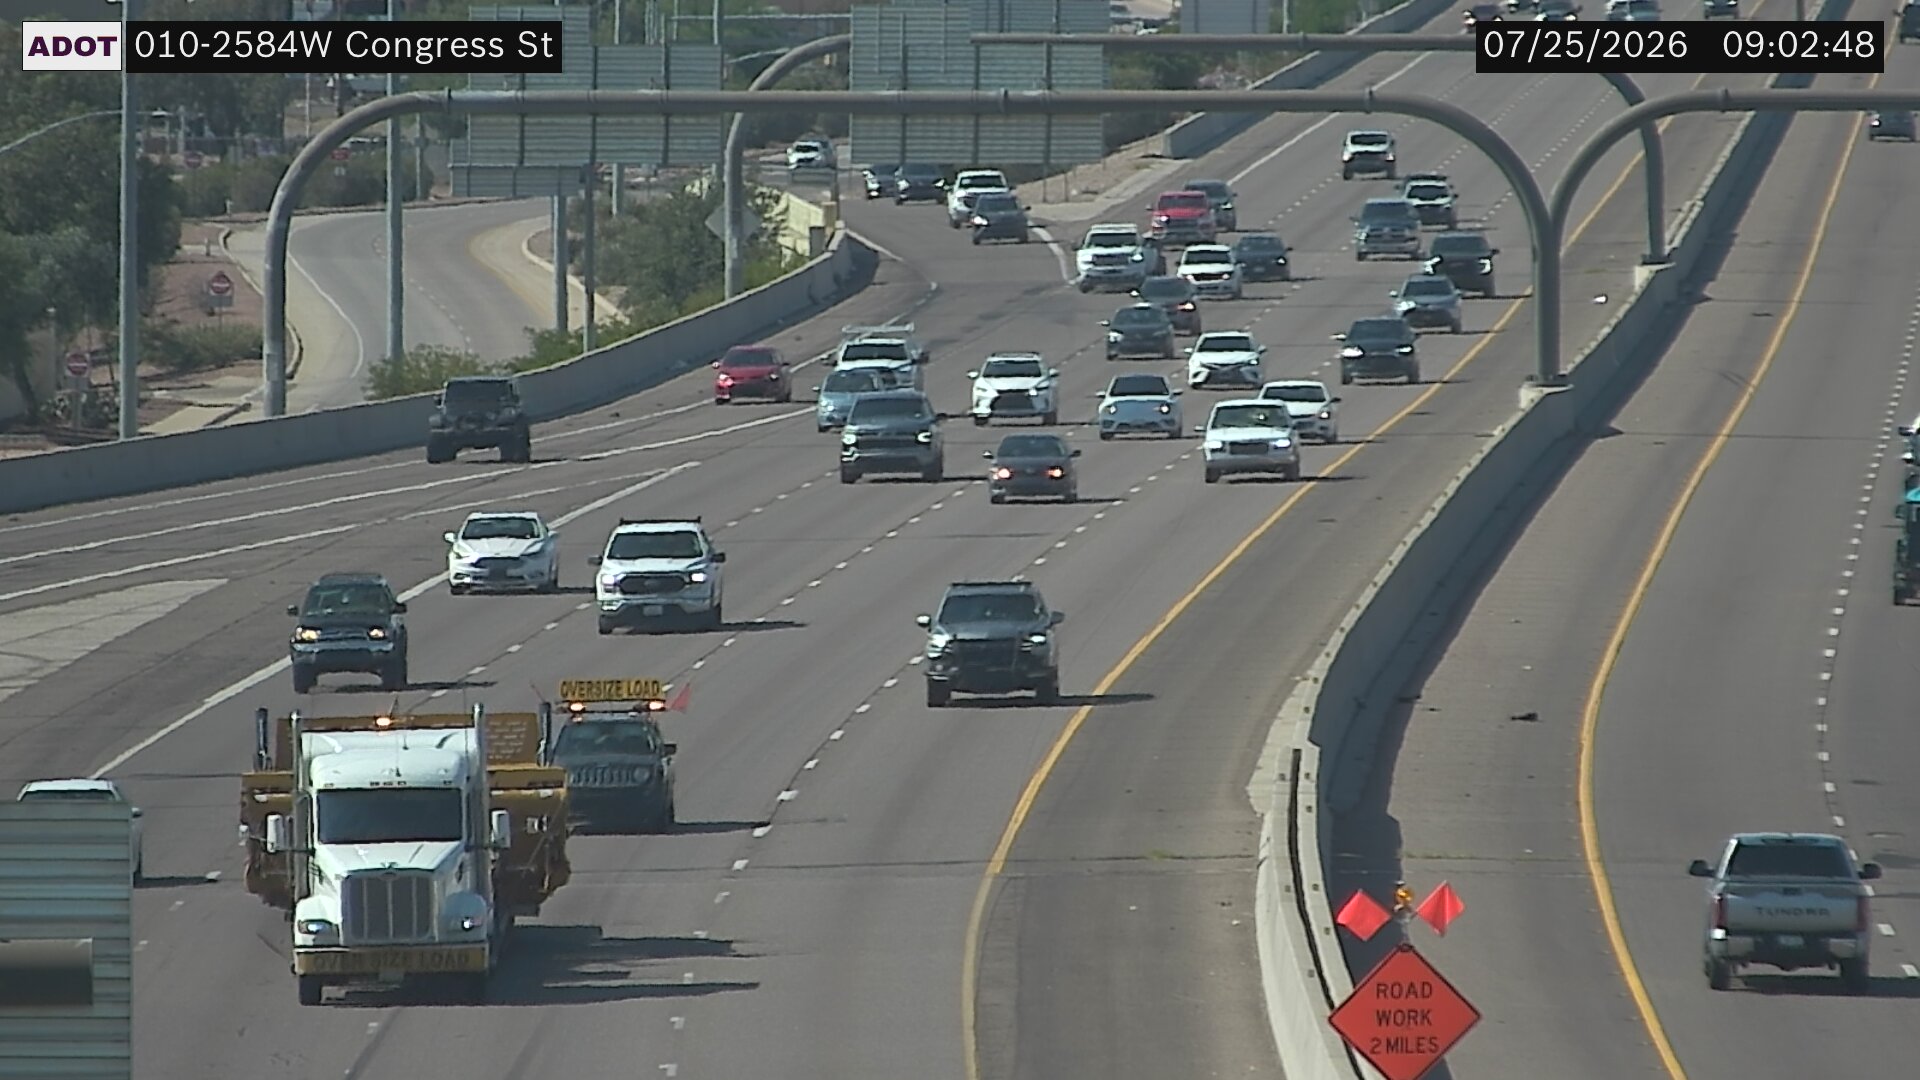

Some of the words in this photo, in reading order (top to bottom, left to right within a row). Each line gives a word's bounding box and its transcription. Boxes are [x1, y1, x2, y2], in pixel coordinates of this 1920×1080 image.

[561, 680, 623, 698] OVERSIZE
[627, 680, 660, 697] LOAD
[1755, 906, 1829, 917] TUNDRA
[420, 951, 469, 967] LOAD
[1376, 982, 1433, 999] ROAD
[1376, 1009, 1432, 1027] WORK
[1369, 1037, 1382, 1055] 2
[1386, 1036, 1440, 1055] MILES
